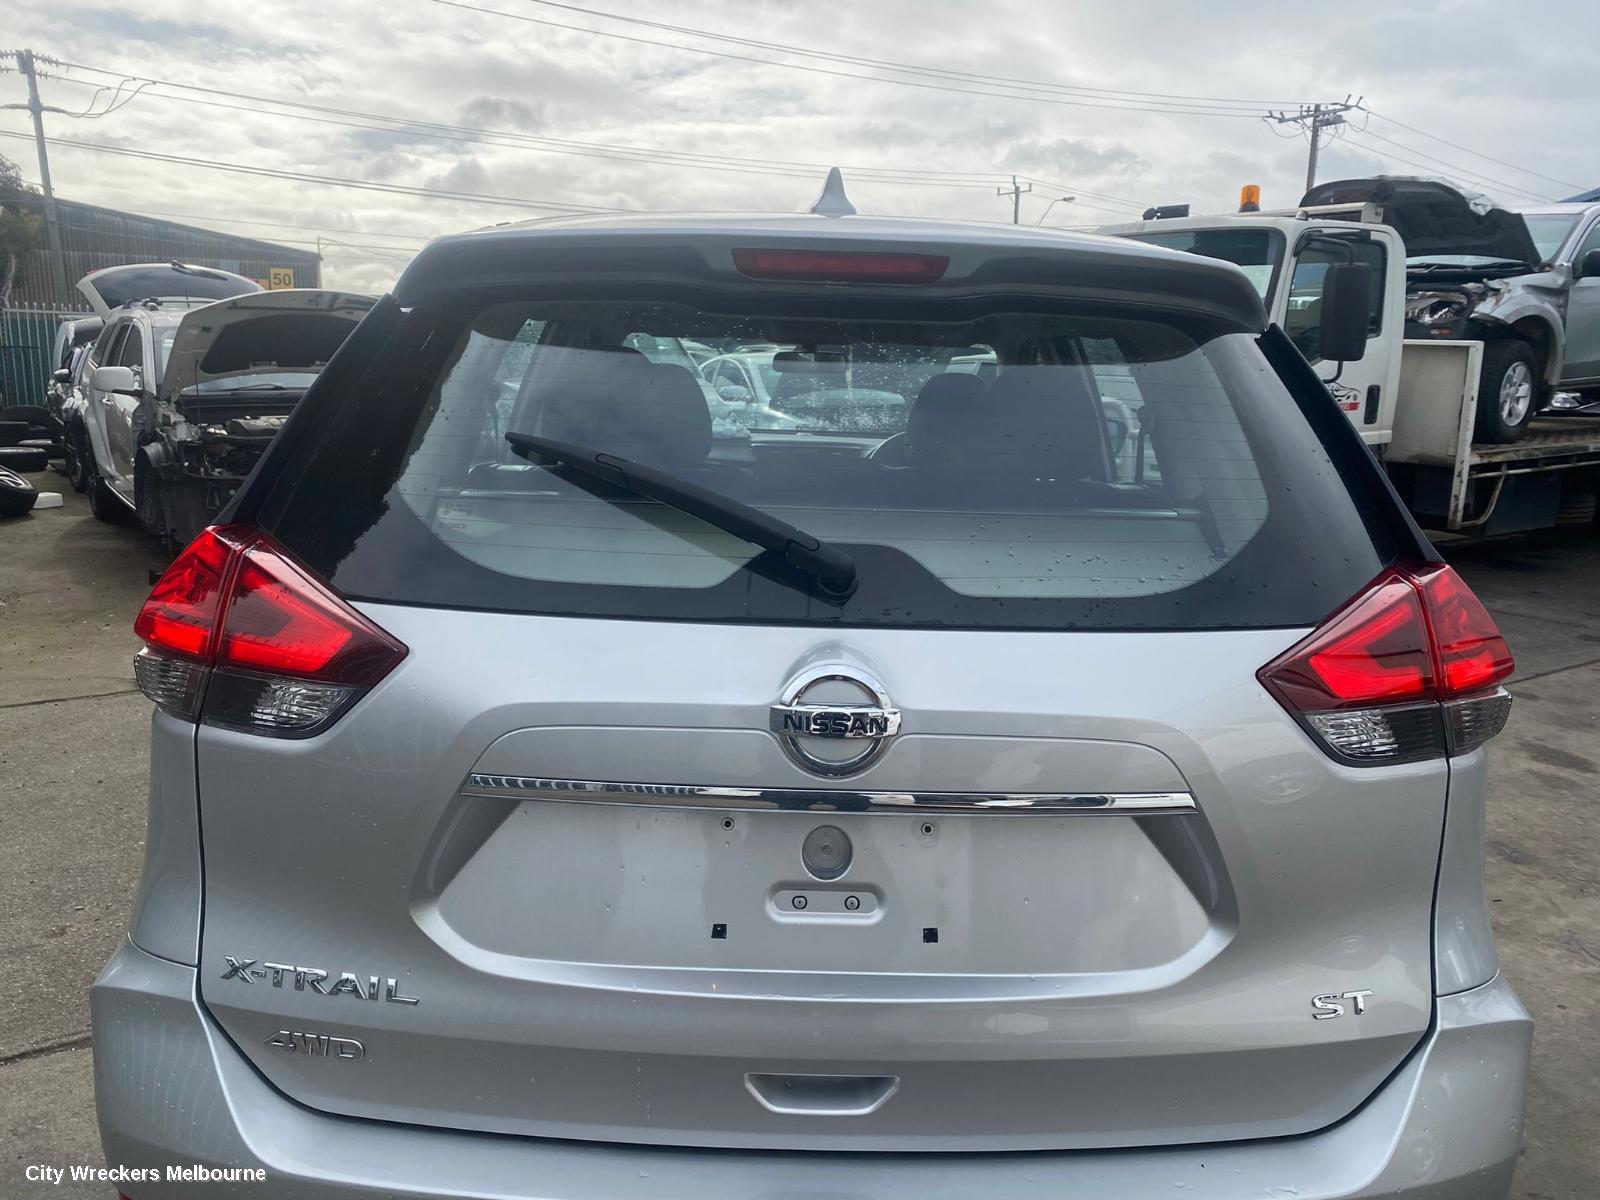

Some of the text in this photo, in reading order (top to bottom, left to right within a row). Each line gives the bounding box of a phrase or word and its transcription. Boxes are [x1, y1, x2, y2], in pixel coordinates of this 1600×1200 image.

[273, 273, 292, 286] 50
[783, 712, 889, 734] NISSAN
[220, 955, 420, 1006] X-TRAIL
[1311, 989, 1375, 1020] ST
[264, 1030, 366, 1060] 4WD
